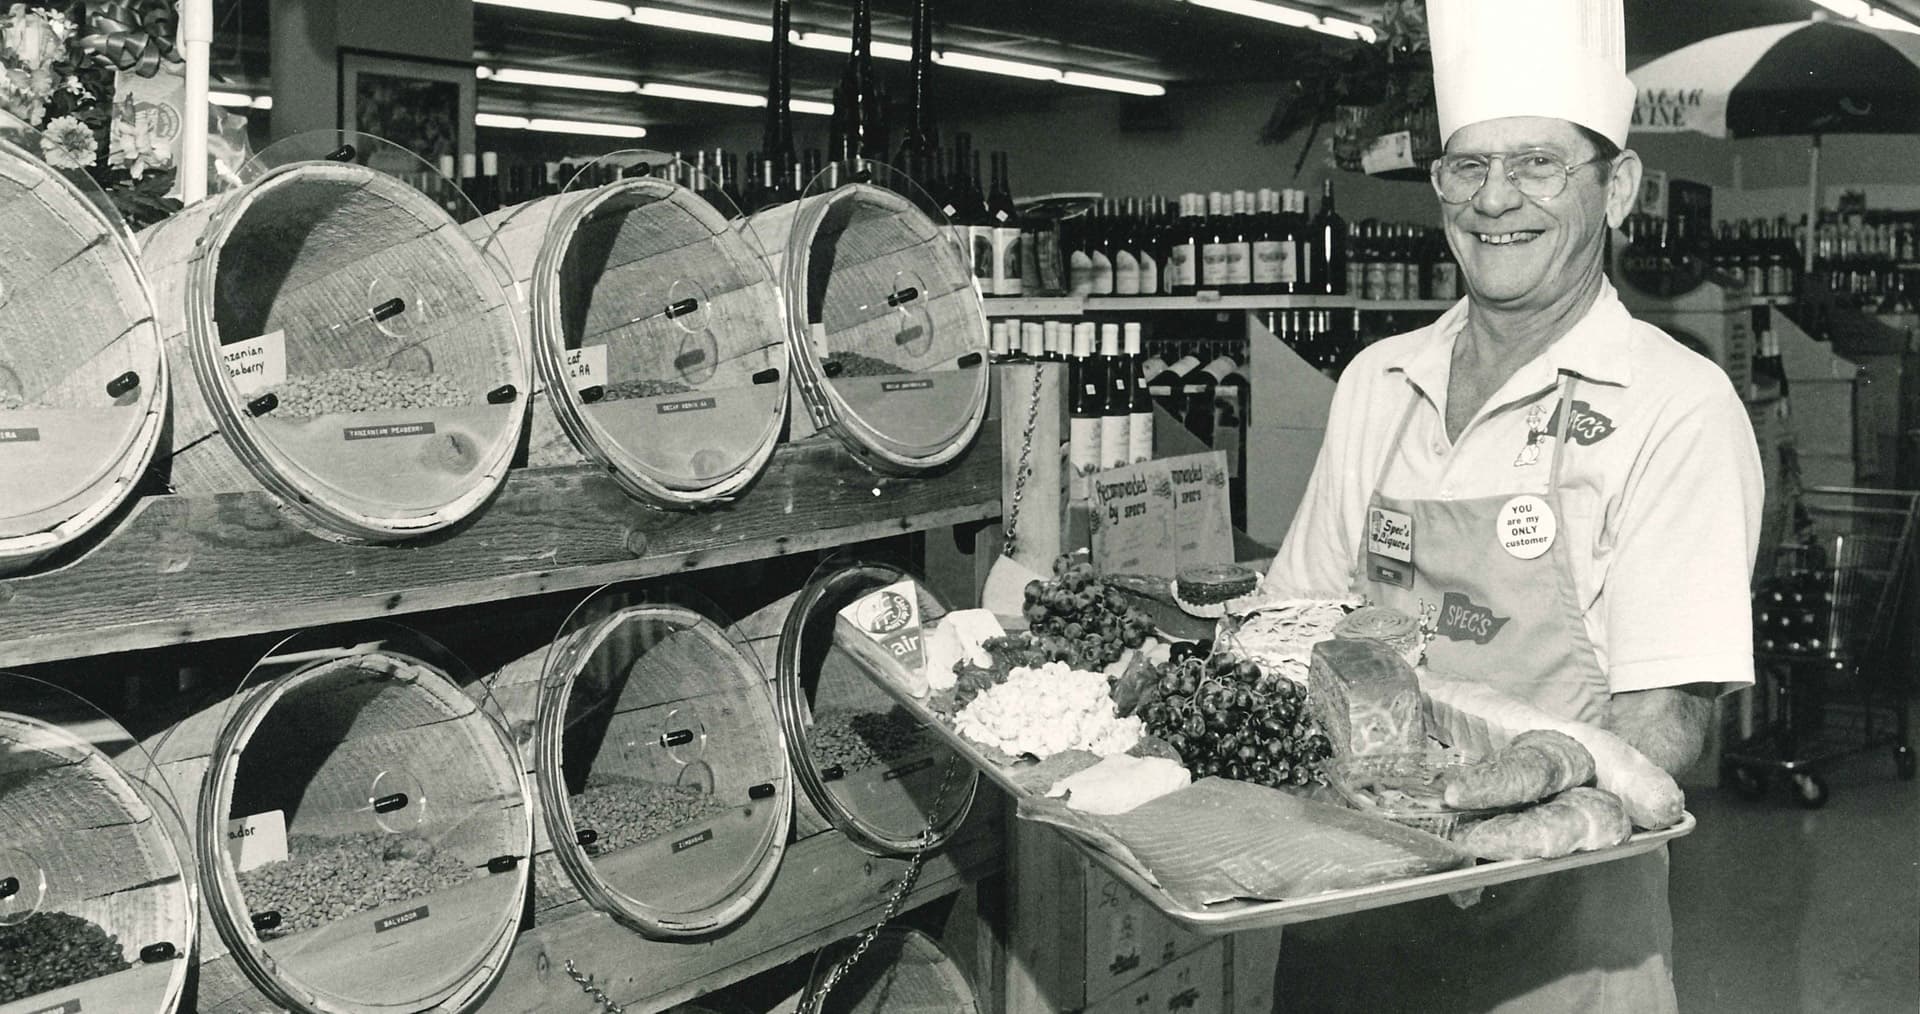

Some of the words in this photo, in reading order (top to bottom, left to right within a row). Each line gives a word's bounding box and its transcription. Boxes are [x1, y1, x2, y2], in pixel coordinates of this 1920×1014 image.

[1512, 504, 1532, 514] YOU
[1507, 518, 1521, 526] are
[1526, 515, 1539, 523] my
[1511, 525, 1537, 536] ONLY
[1505, 536, 1548, 548] customer
[1446, 604, 1492, 636] SPEC'S
[229, 825, 256, 839] ador
